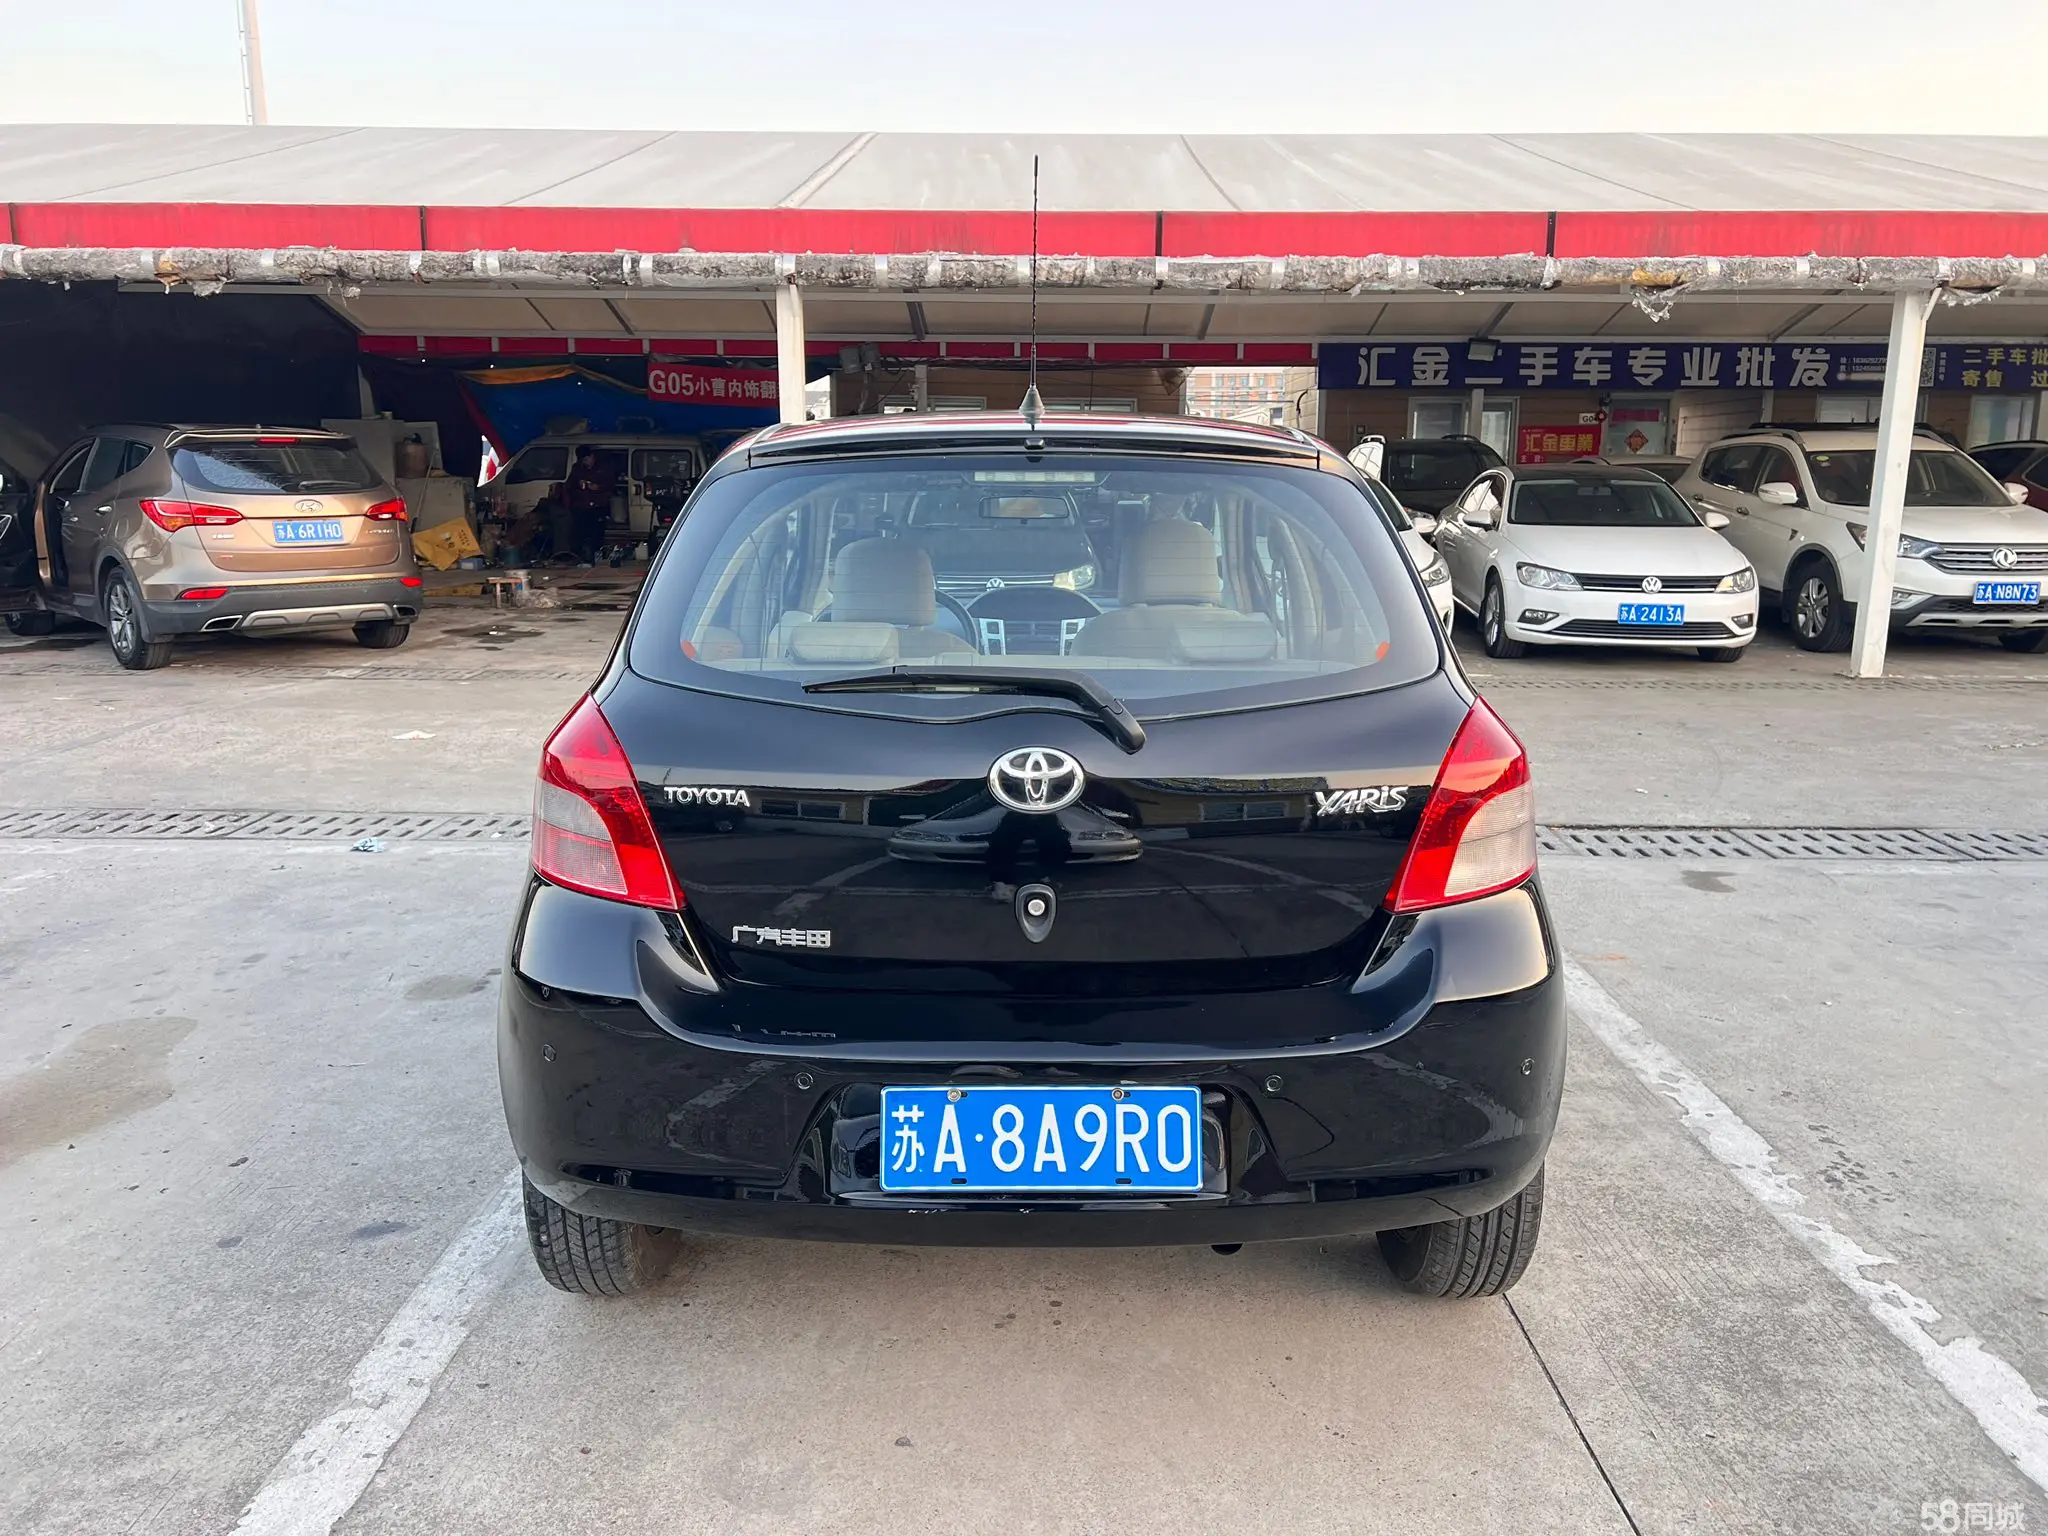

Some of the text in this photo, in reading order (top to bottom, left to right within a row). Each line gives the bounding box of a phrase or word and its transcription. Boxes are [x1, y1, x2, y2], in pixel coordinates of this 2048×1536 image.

[648, 369, 780, 399] G05小曹内饰翻
[1582, 415, 1597, 423] G0
[664, 786, 750, 808] TOYOTA
[731, 925, 832, 949] 广汽丰田
